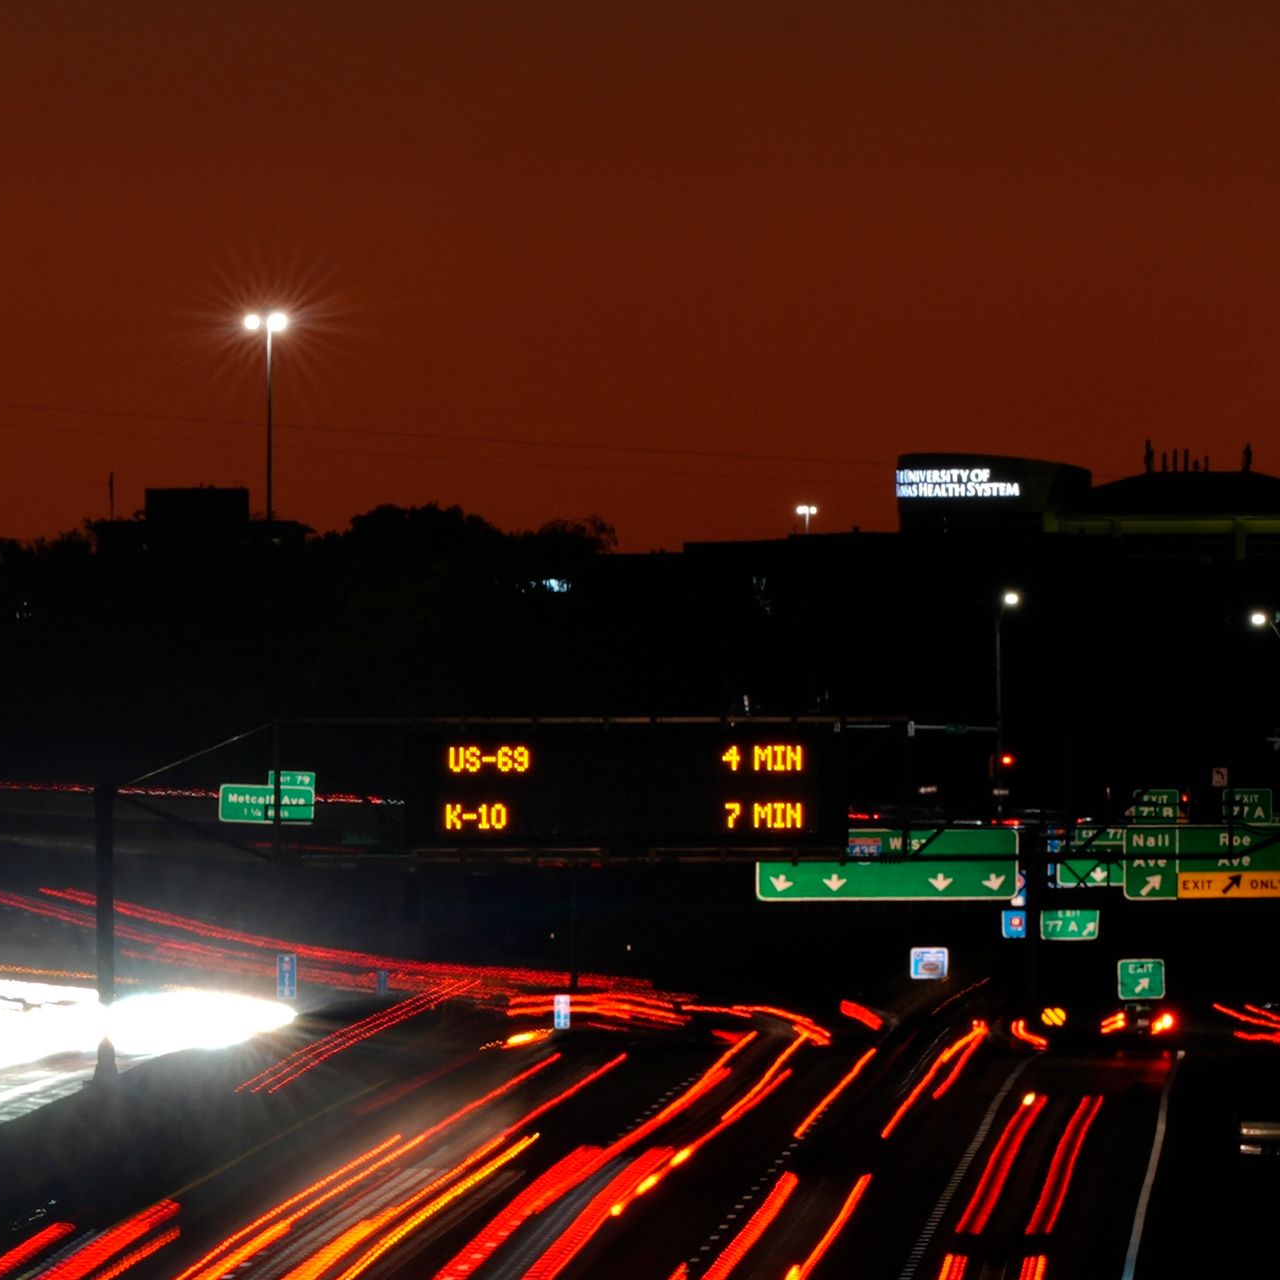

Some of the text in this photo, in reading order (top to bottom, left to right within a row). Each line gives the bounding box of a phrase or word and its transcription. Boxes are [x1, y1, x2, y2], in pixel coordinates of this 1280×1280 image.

[970, 468, 990, 483] OF
[919, 482, 965, 497] HEALTH
[966, 481, 1020, 496] SYSTEM
[448, 745, 530, 773] US-69
[721, 744, 803, 771] 4 MIN
[295, 775, 311, 785] 79
[227, 792, 306, 806] Metcalf Ave
[1234, 794, 1260, 803] EXIT
[445, 803, 508, 830] K-10
[724, 802, 803, 829] 7 MIN
[1131, 833, 1171, 847] Nall
[1218, 832, 1252, 847] Roe
[1131, 857, 1168, 869] Ave
[1217, 855, 1252, 867] Ave
[1182, 879, 1280, 891] EXIT ONL
[1045, 919, 1079, 933] 77 A
[1128, 963, 1154, 975] EXIT
